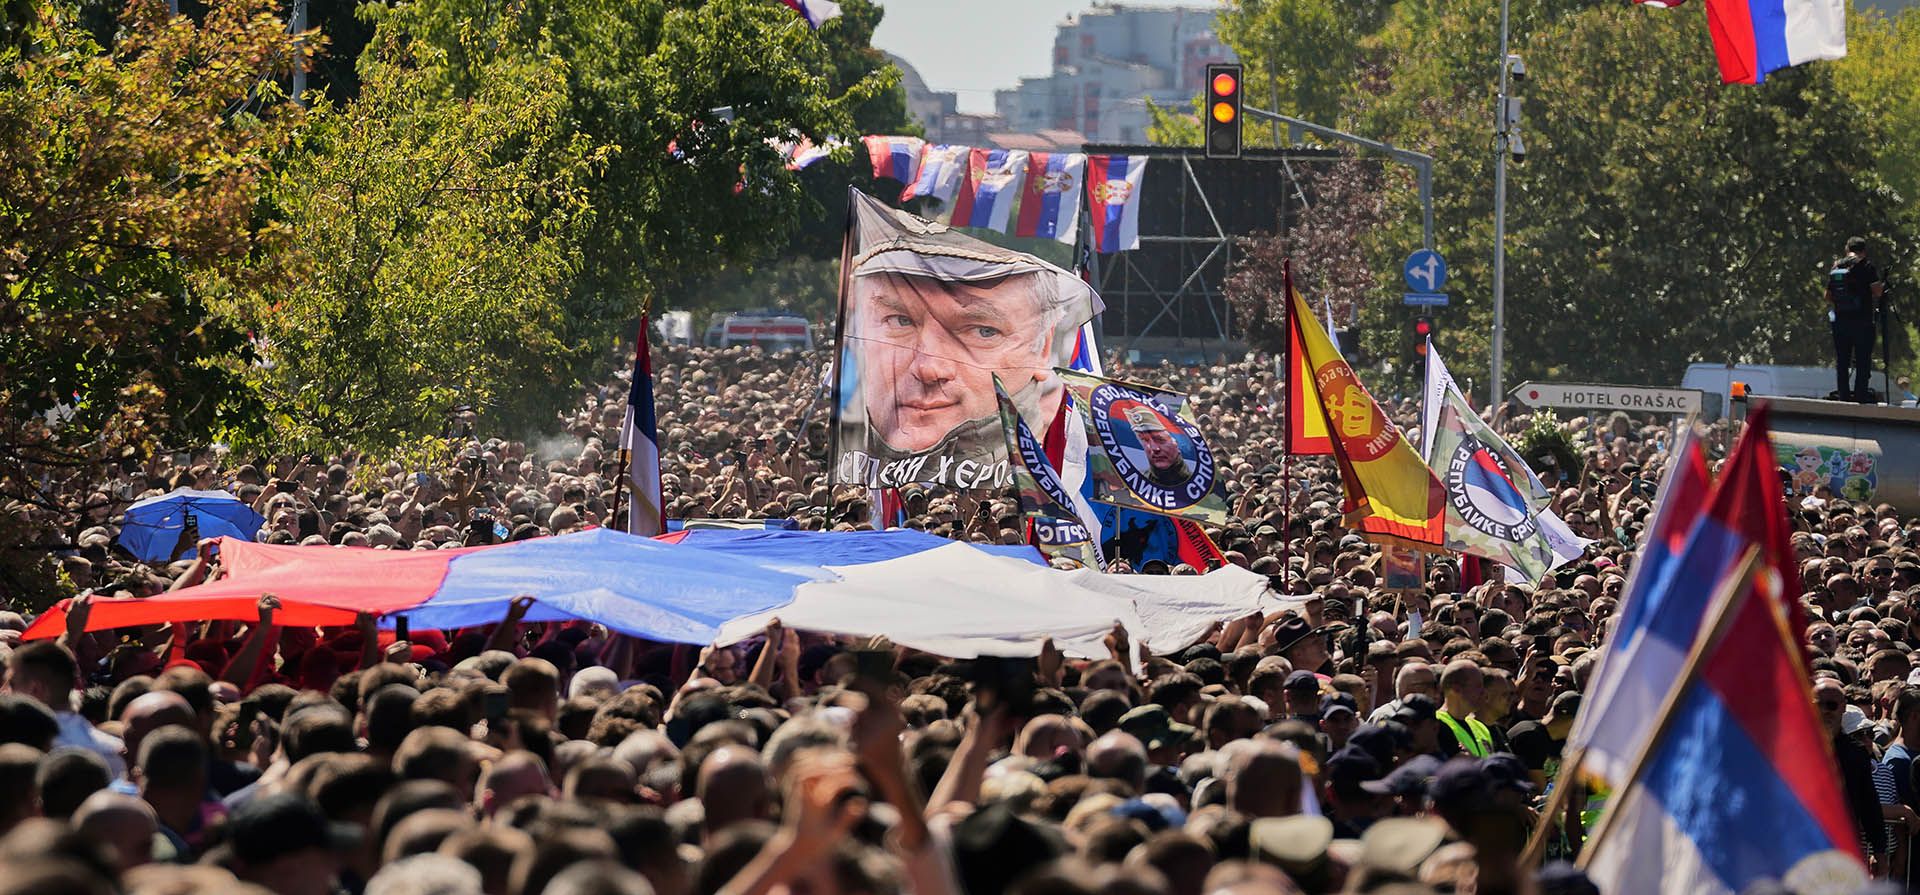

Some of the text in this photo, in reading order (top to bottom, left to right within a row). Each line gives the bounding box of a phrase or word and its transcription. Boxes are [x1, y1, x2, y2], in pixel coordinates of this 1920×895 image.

[1098, 385, 1169, 417] ВОЈСКА
[1563, 391, 1687, 409] HOTEL ORAŠAC
[1018, 423, 1077, 517] РЕПУБЛИ
[1093, 406, 1213, 507] РЕПУБЛИКЕ СРПСКЕ
[1450, 447, 1505, 538] РЕПУБЛИКЕ
